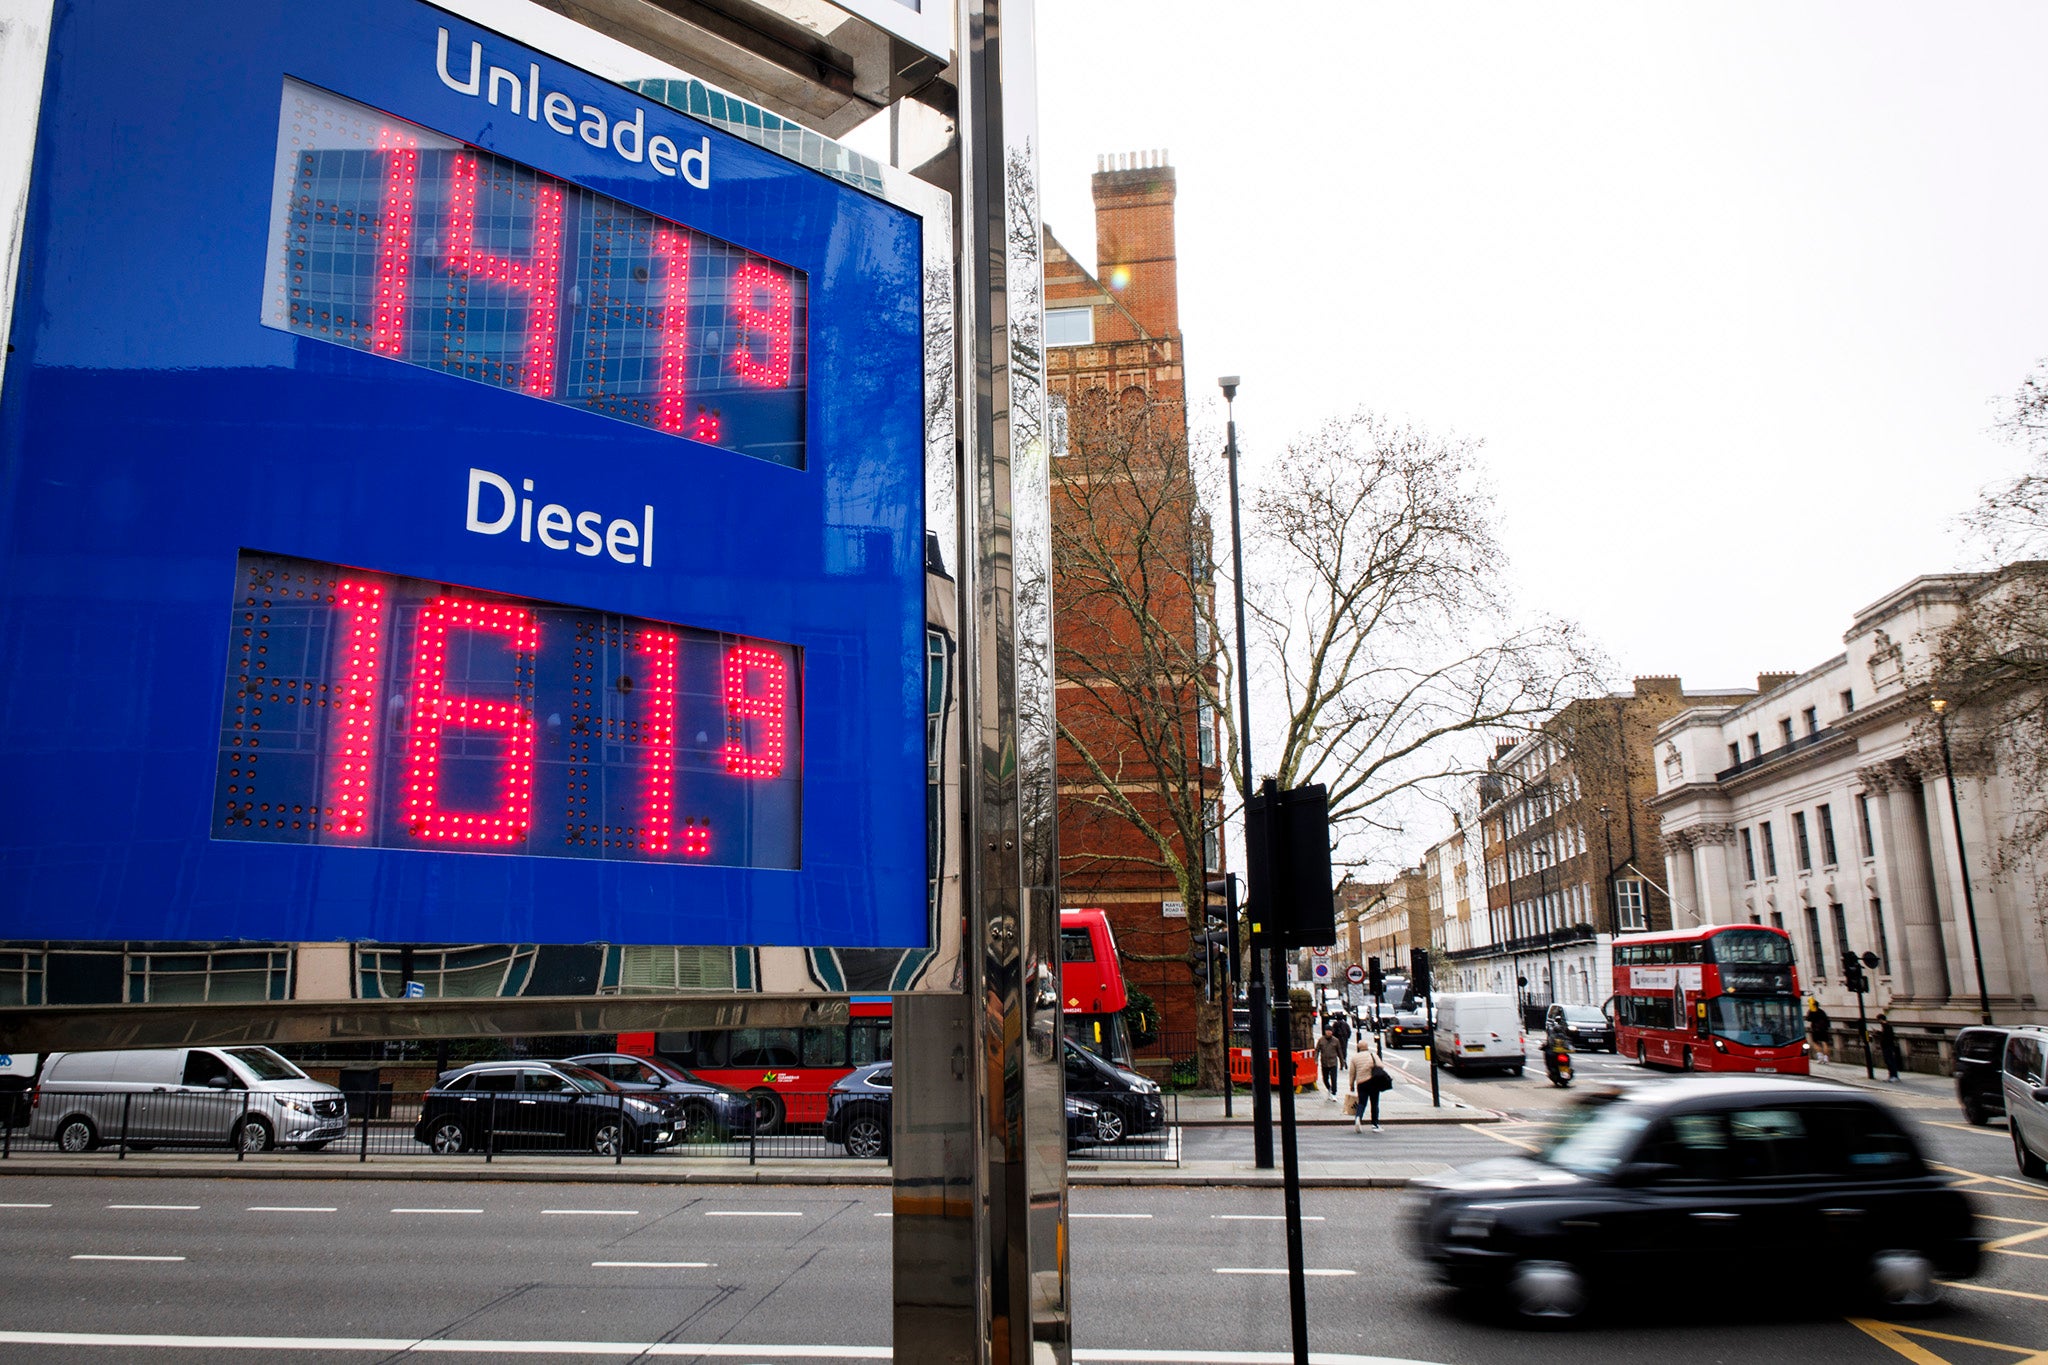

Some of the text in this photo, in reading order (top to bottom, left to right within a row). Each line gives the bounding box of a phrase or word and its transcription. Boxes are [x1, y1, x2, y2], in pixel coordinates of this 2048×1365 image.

[435, 26, 712, 190] Unleaded
[466, 468, 654, 567] Diesel
[1774, 976, 1783, 987] 2
